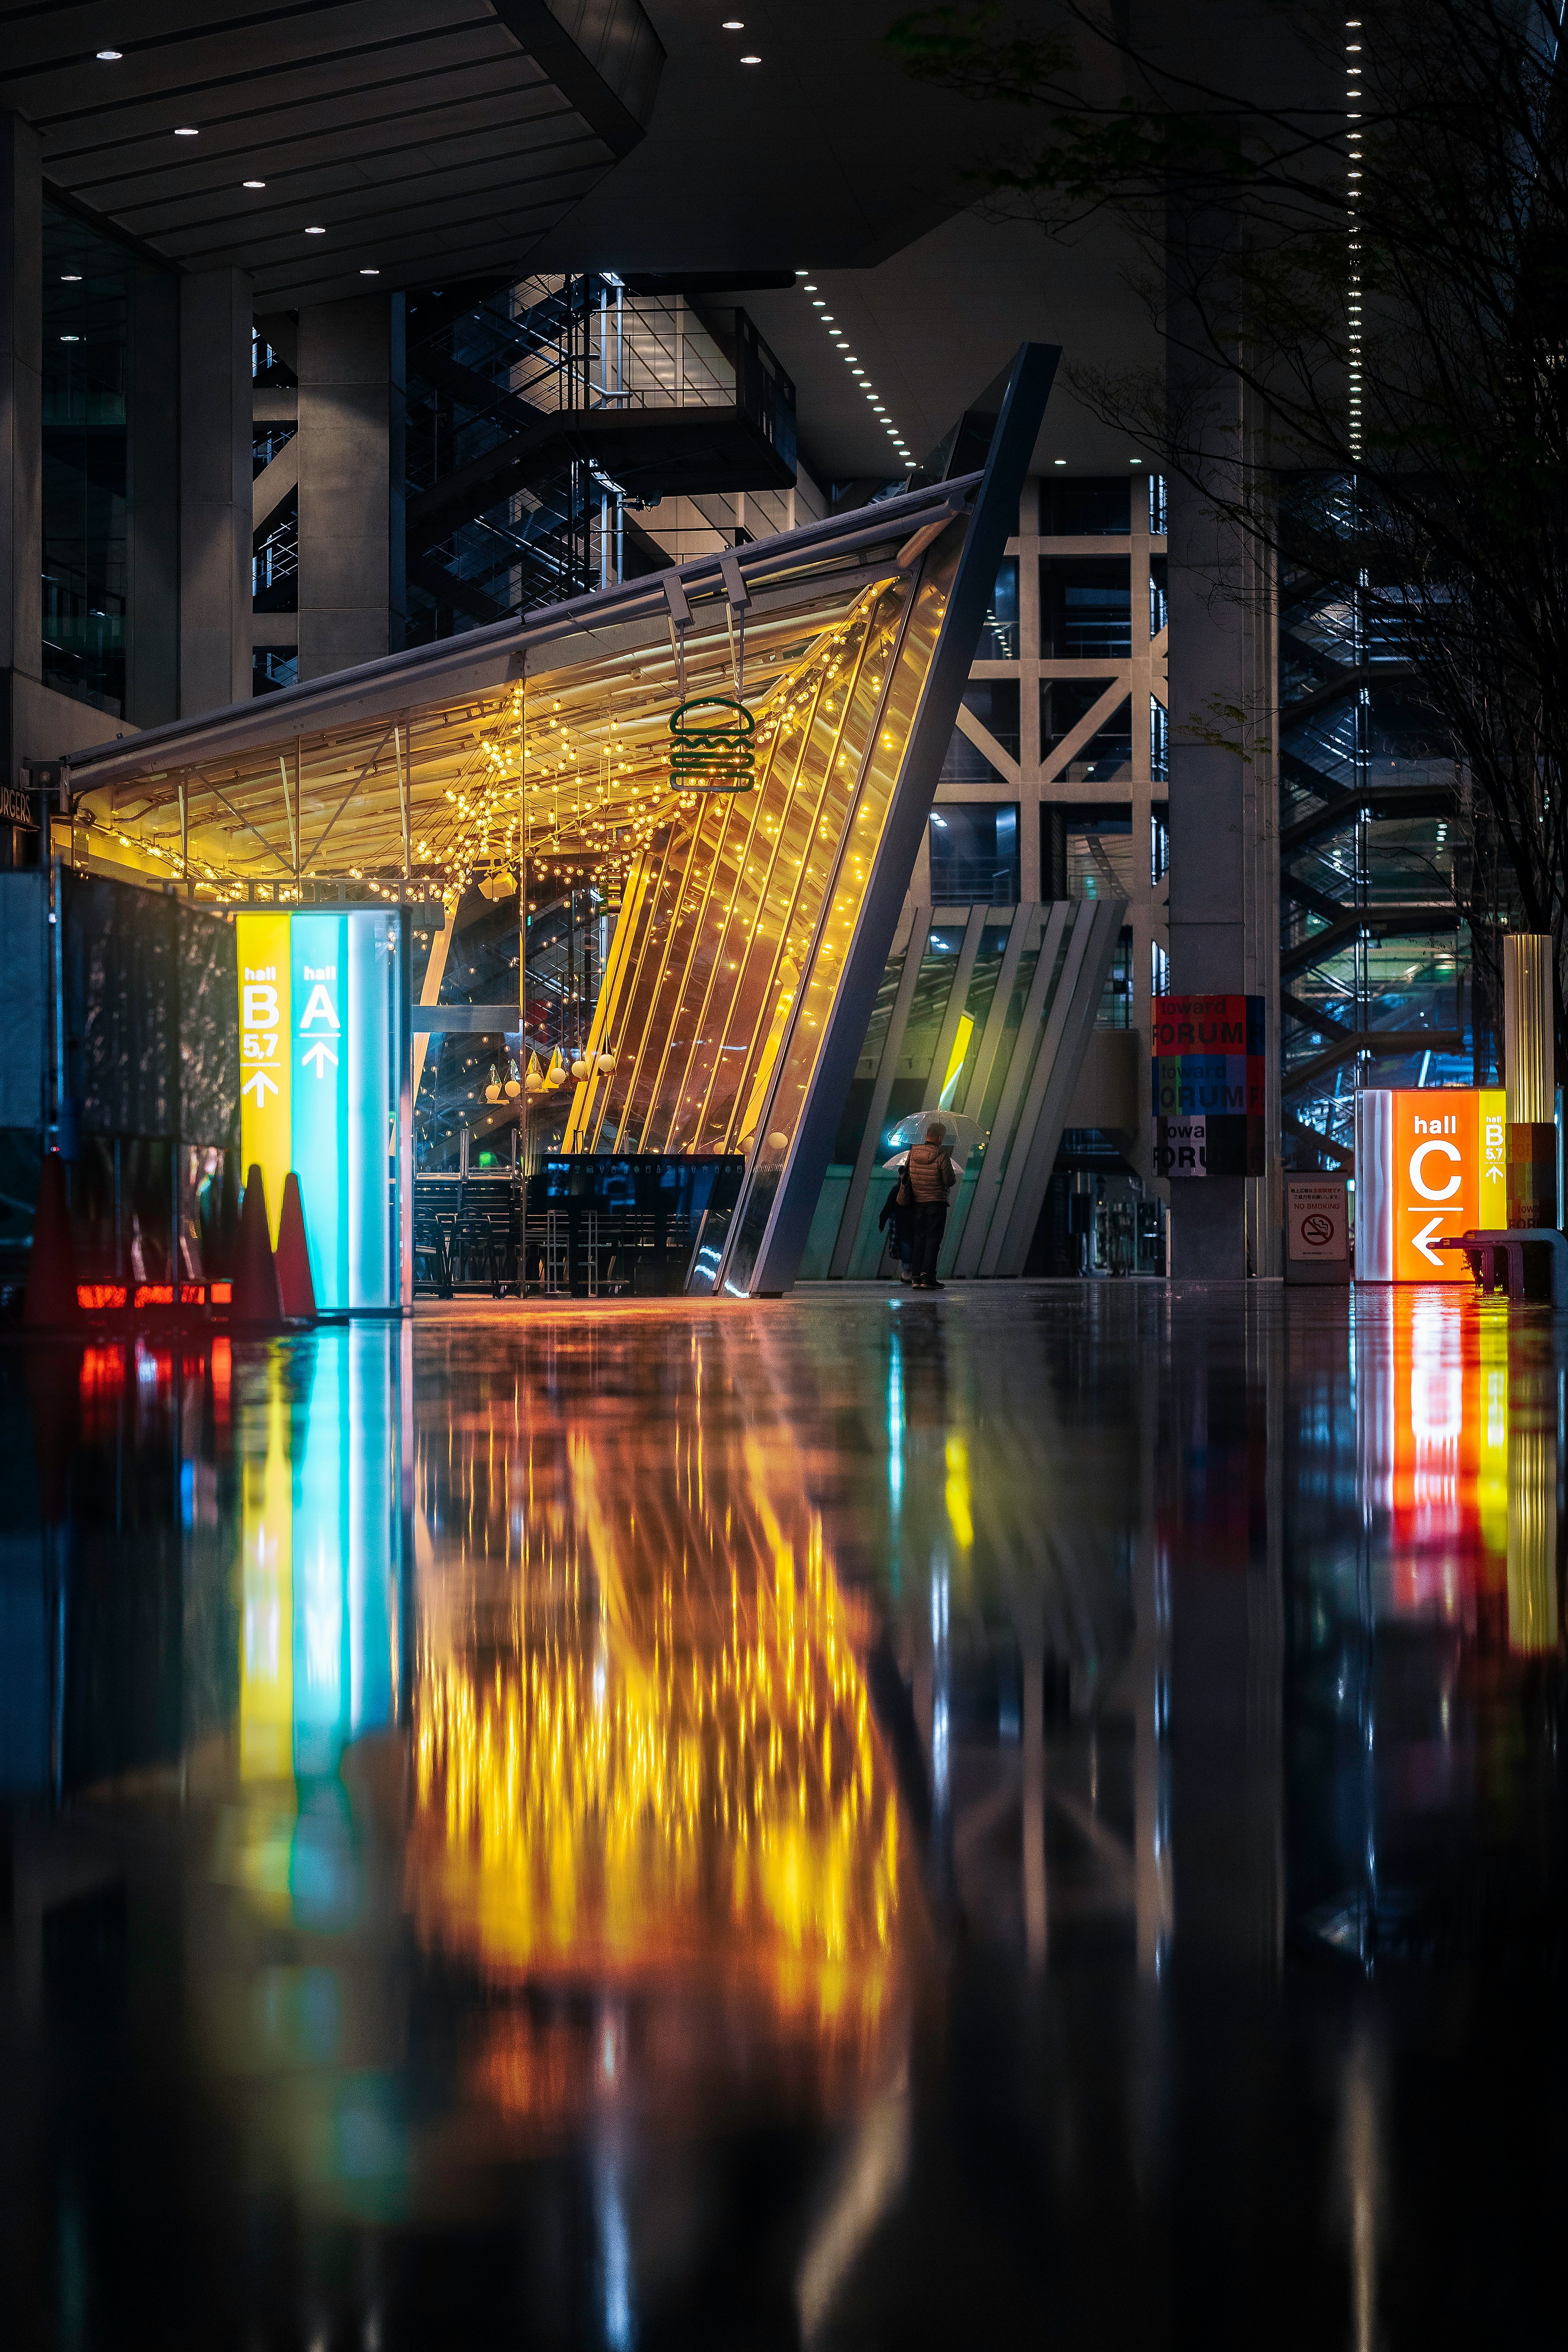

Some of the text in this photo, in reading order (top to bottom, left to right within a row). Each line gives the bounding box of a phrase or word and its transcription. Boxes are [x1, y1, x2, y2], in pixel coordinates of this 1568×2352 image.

[244, 966, 276, 981] hall
[304, 966, 336, 980] hall
[243, 985, 280, 1029] B
[299, 984, 341, 1029] A
[1161, 999, 1226, 1015] toward
[1152, 1022, 1243, 1046] FORUM
[243, 1034, 278, 1059] 5,7
[1162, 1062, 1226, 1079] toward
[1160, 1086, 1244, 1109] ORUM
[1414, 1115, 1457, 1134] hall
[1486, 1124, 1504, 1146] B
[1486, 1148, 1503, 1160] 5,7
[1409, 1140, 1462, 1200] C
